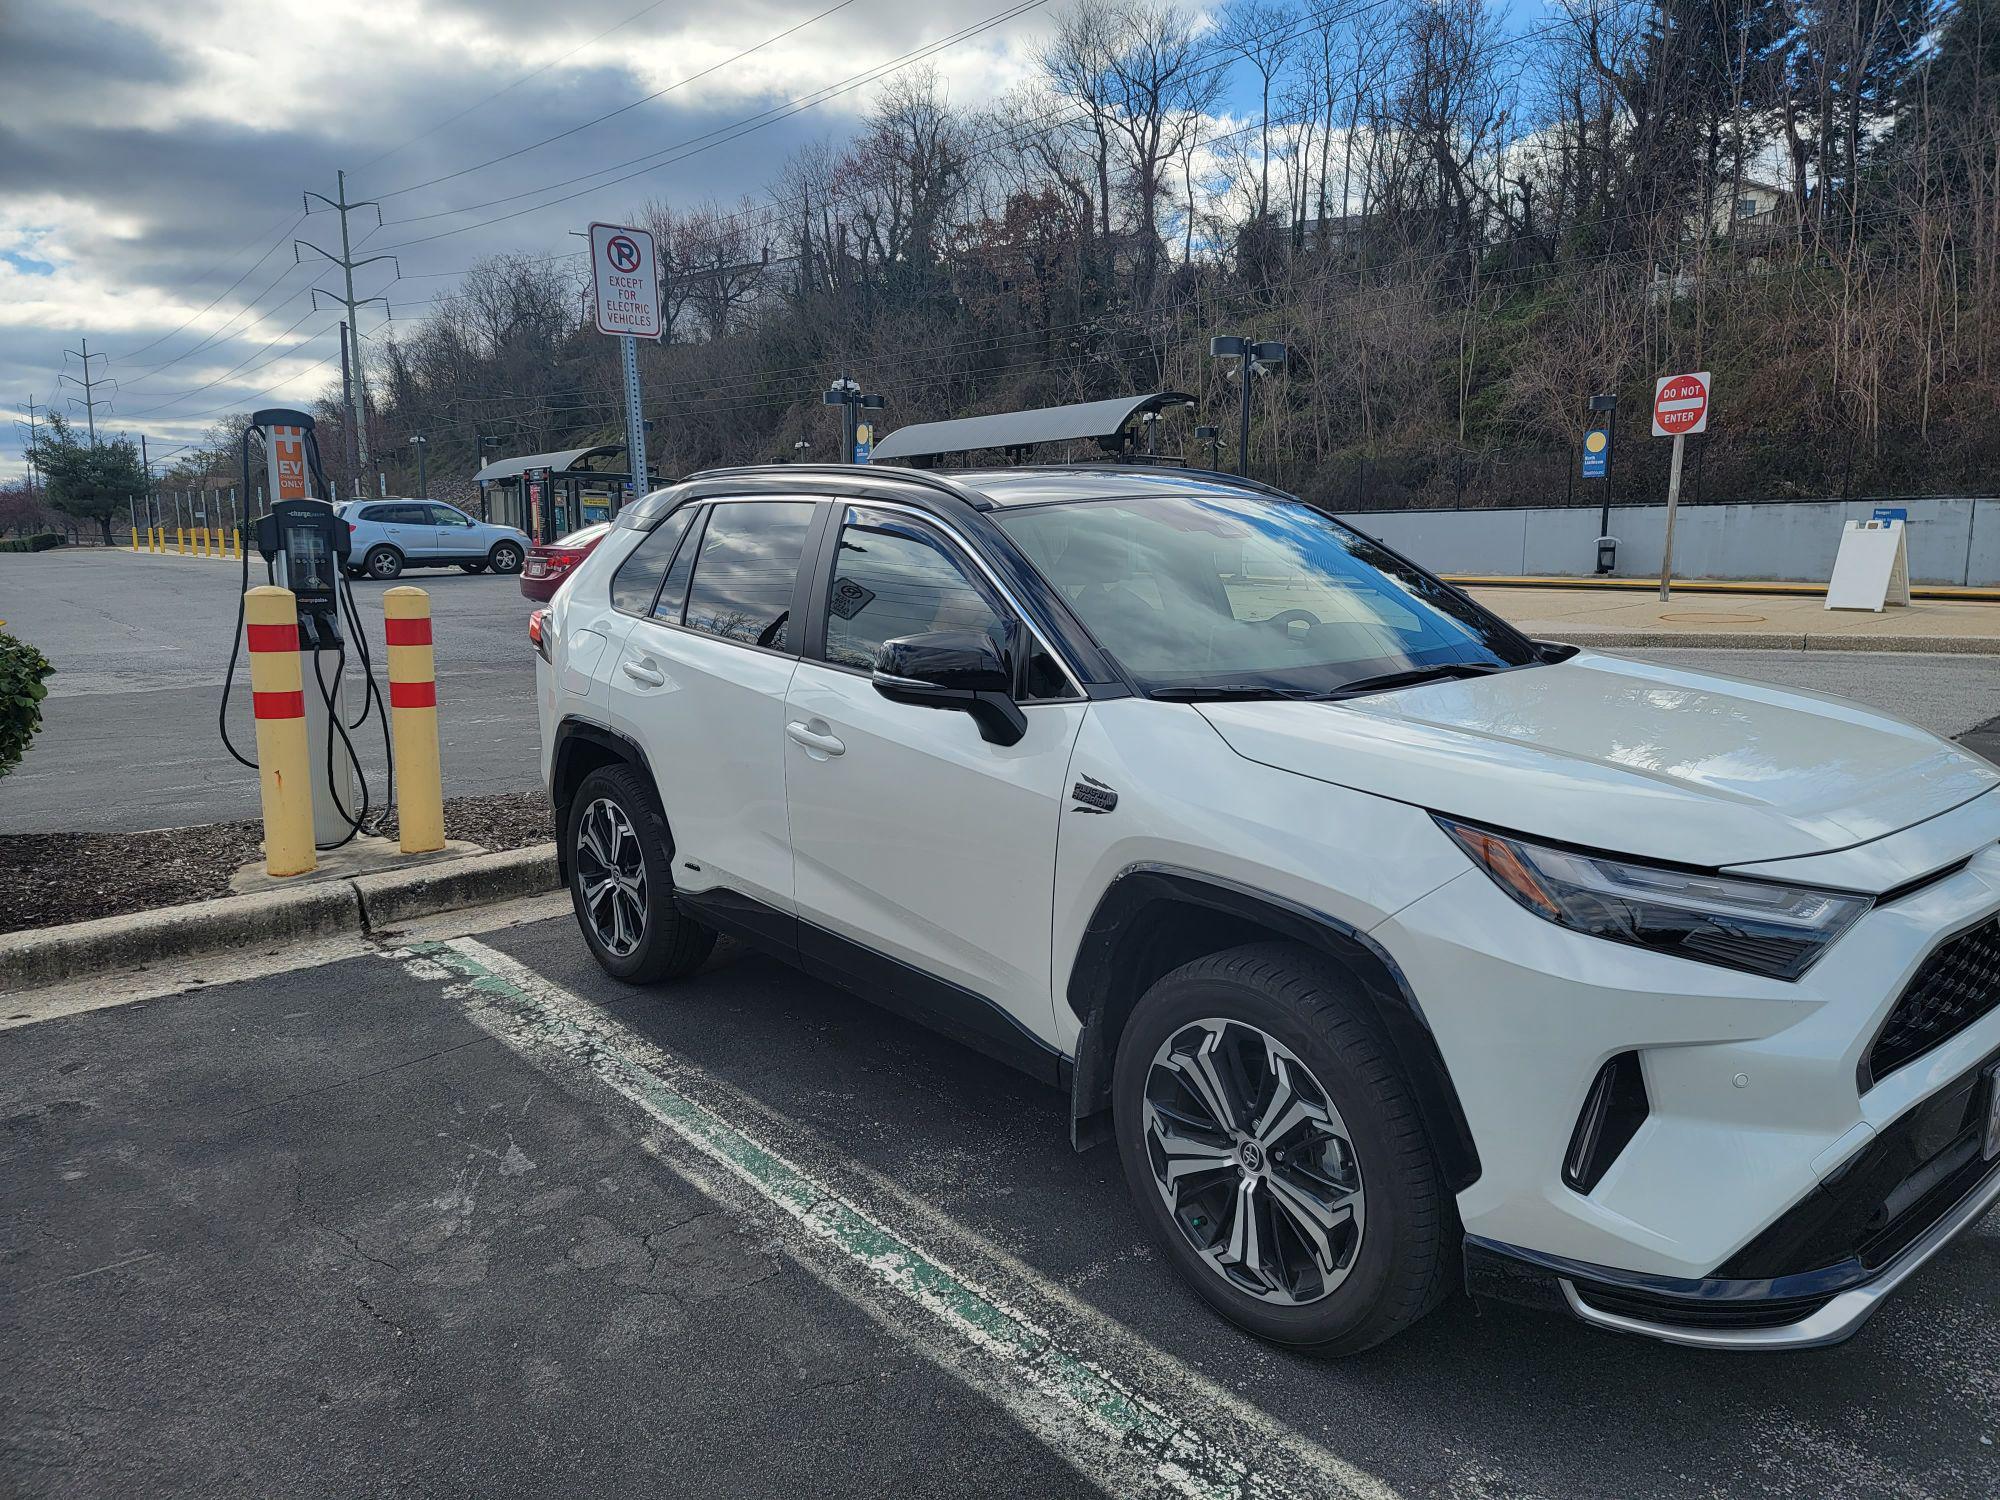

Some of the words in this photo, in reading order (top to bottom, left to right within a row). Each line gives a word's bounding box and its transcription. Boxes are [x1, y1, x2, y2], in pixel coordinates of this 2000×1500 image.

[609, 276, 643, 289] EXCEPT
[618, 289, 636, 301] FOR
[607, 300, 650, 314] ELECTRIC
[607, 313, 651, 326] VEHICLES
[1664, 388, 1676, 398] DO
[1681, 385, 1700, 396] NOT
[1664, 412, 1694, 423] ENTER
[279, 460, 302, 474] EV
[280, 480, 304, 489] ONLY
